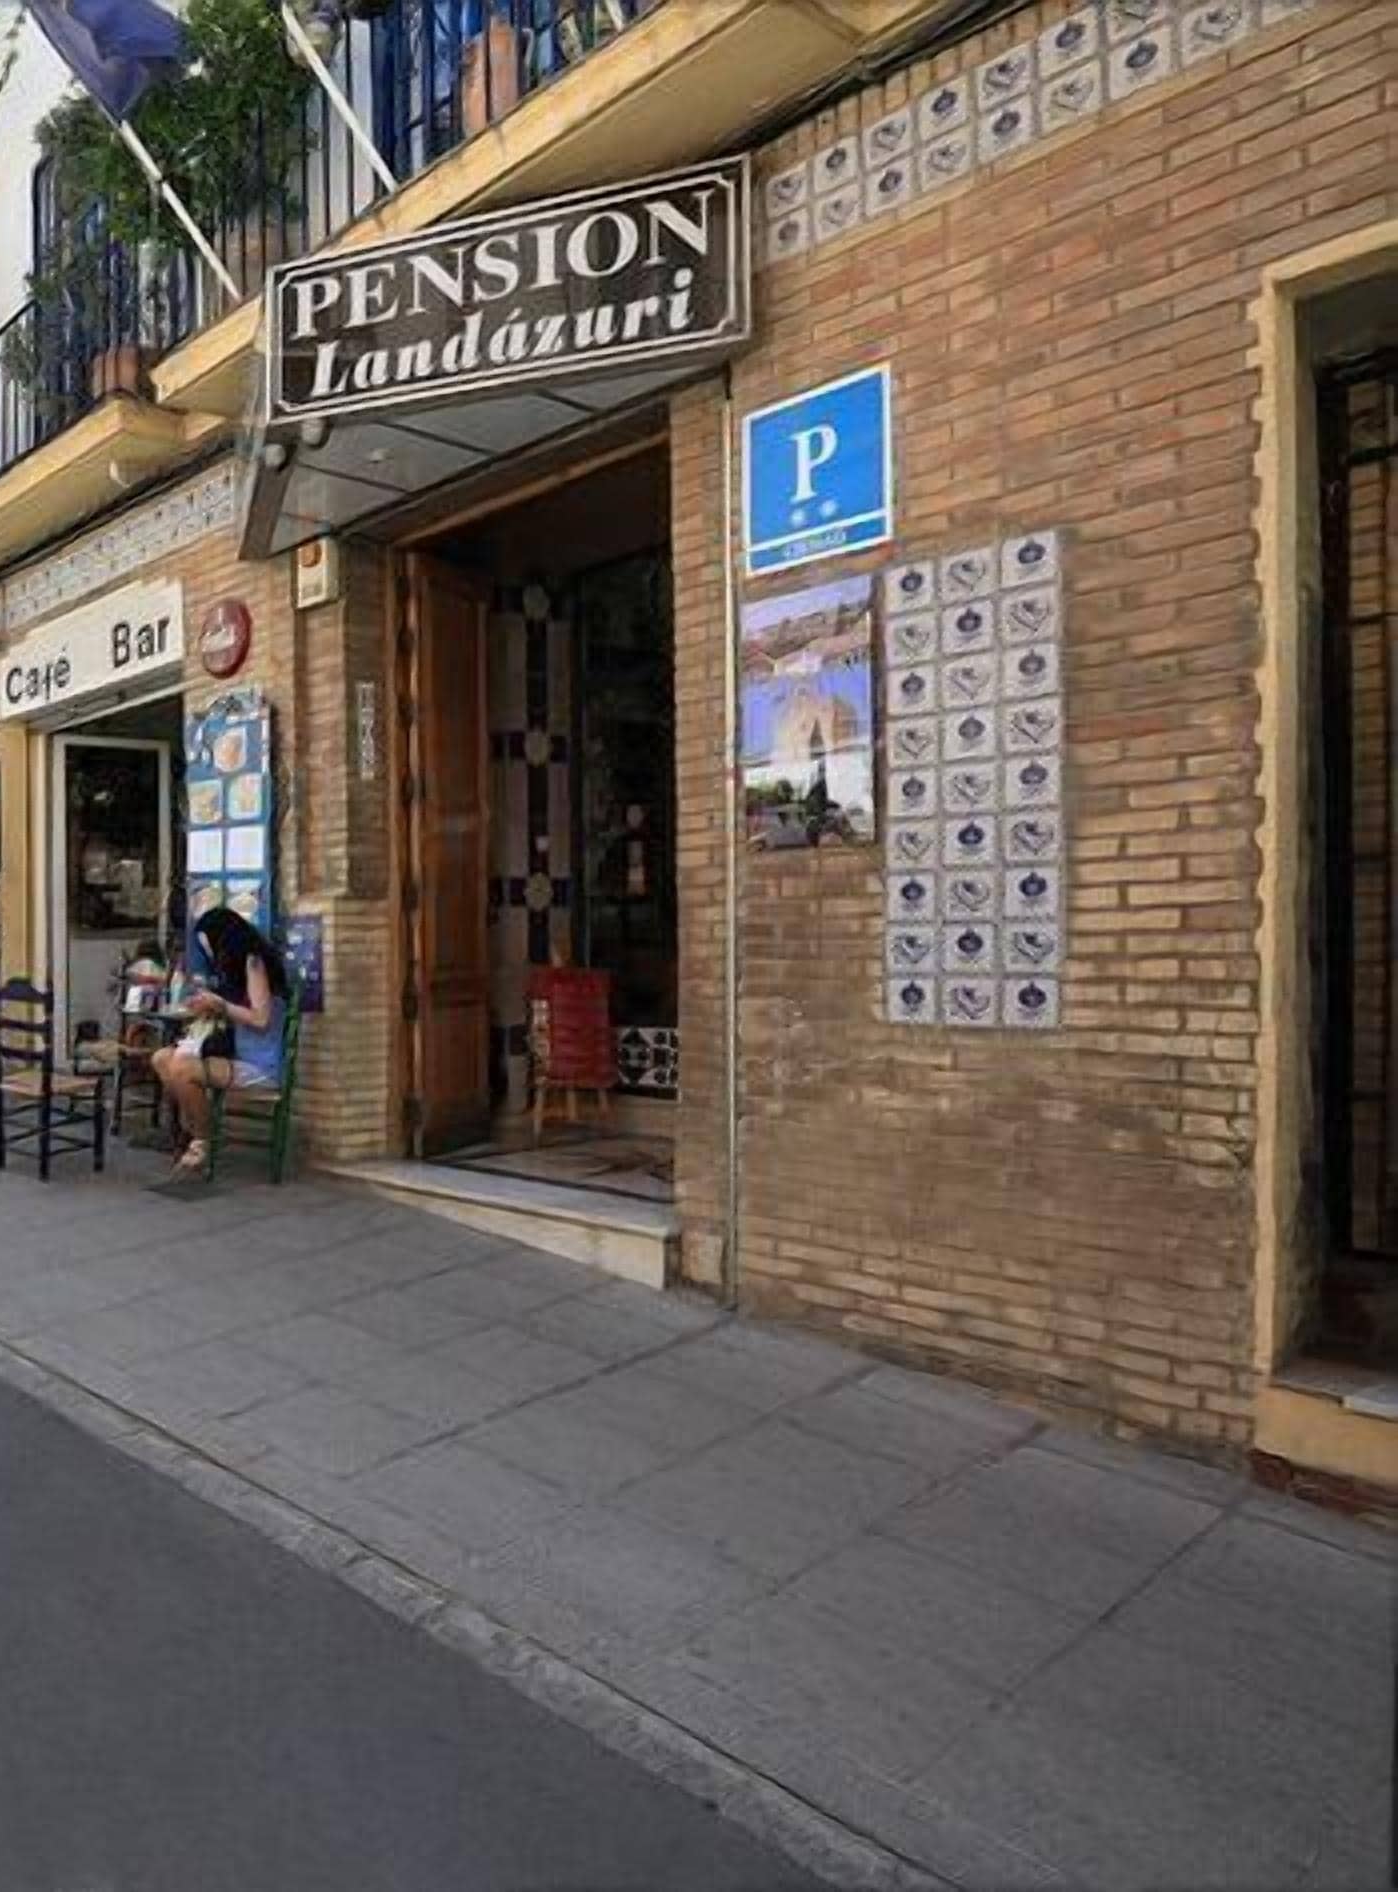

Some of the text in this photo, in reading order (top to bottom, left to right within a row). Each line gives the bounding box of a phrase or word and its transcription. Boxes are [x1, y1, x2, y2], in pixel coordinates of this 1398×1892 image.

[289, 191, 716, 340] PENSION
[311, 268, 694, 397] Landázuri
[789, 423, 837, 503] P
[113, 617, 170, 669] Bar
